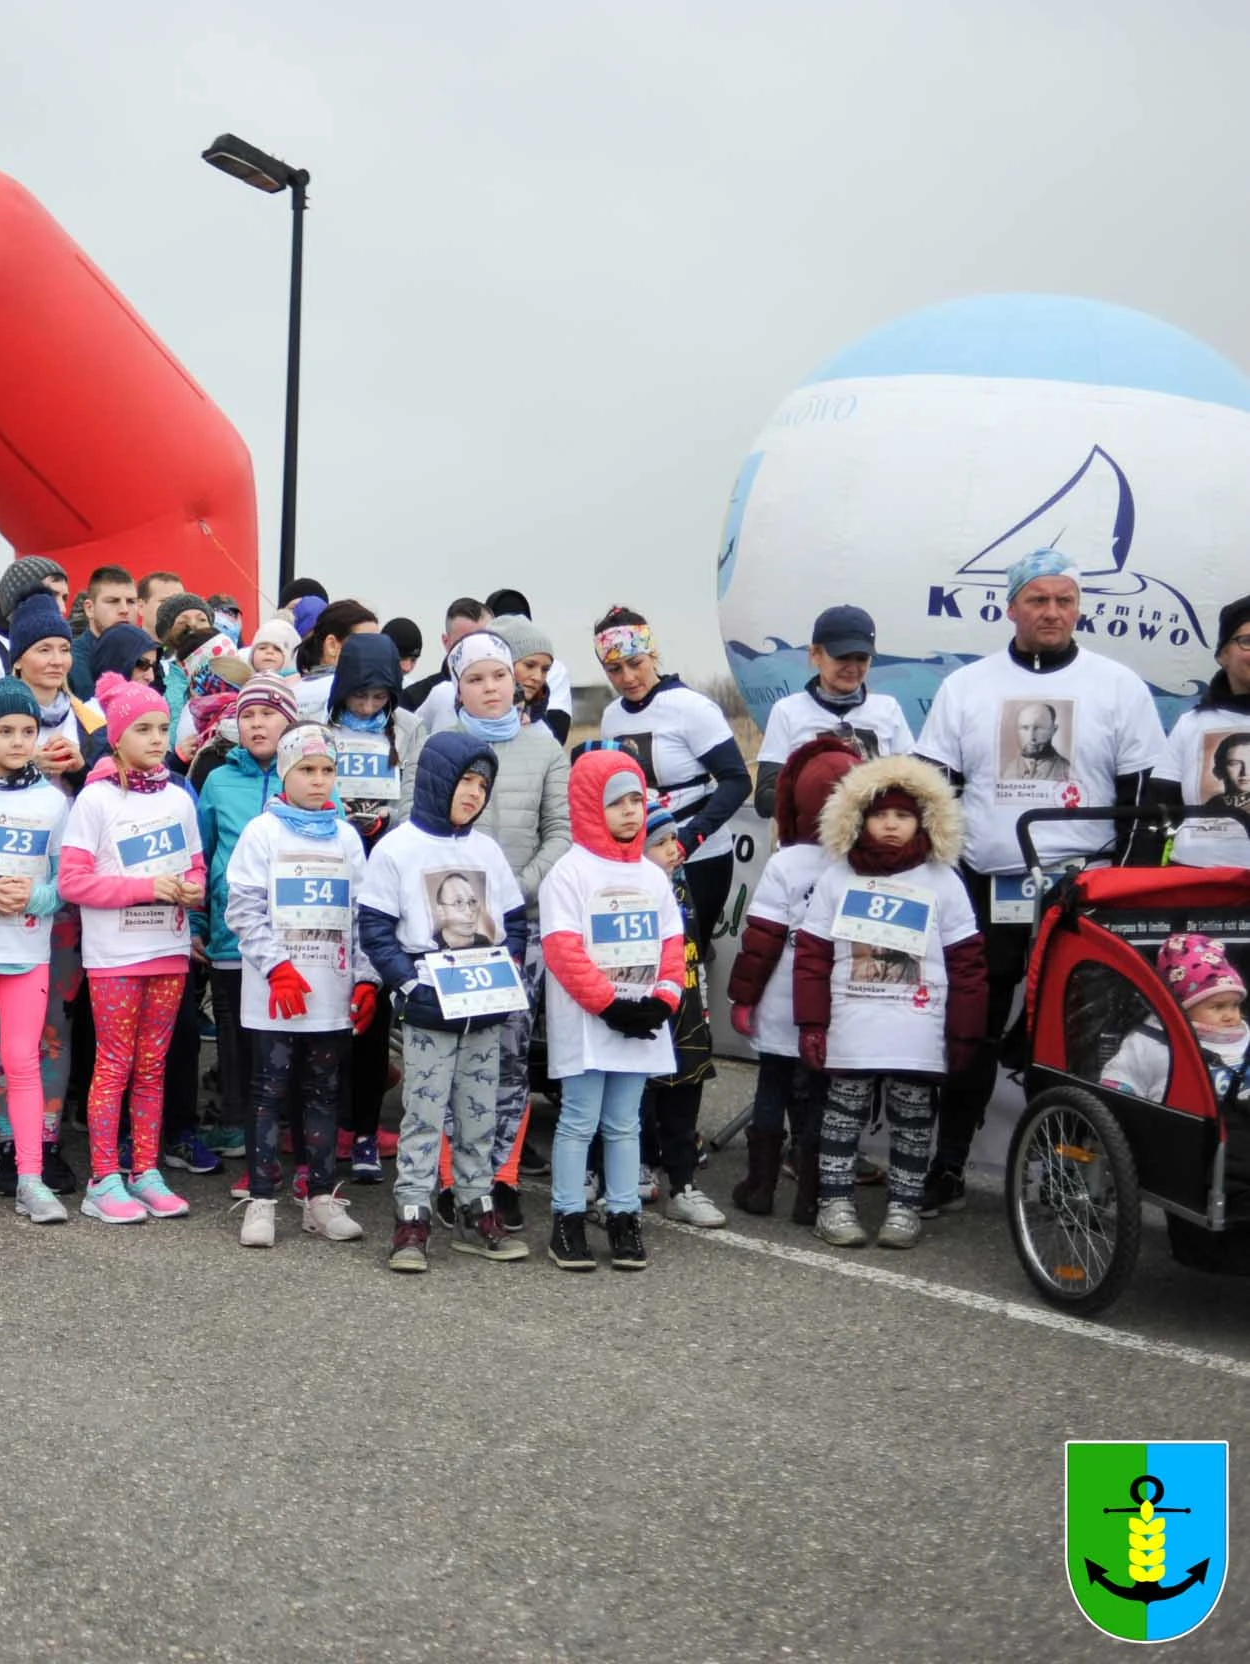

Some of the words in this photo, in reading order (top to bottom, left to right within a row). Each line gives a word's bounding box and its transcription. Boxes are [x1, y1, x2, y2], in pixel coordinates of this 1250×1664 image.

[1095, 602, 1180, 624] gmina
[338, 754, 379, 776] 131
[3, 829, 33, 853] 23
[143, 830, 173, 857] 24
[303, 880, 334, 903] 54
[867, 895, 904, 921] 87
[613, 913, 653, 939] 151
[460, 966, 493, 990] 30
